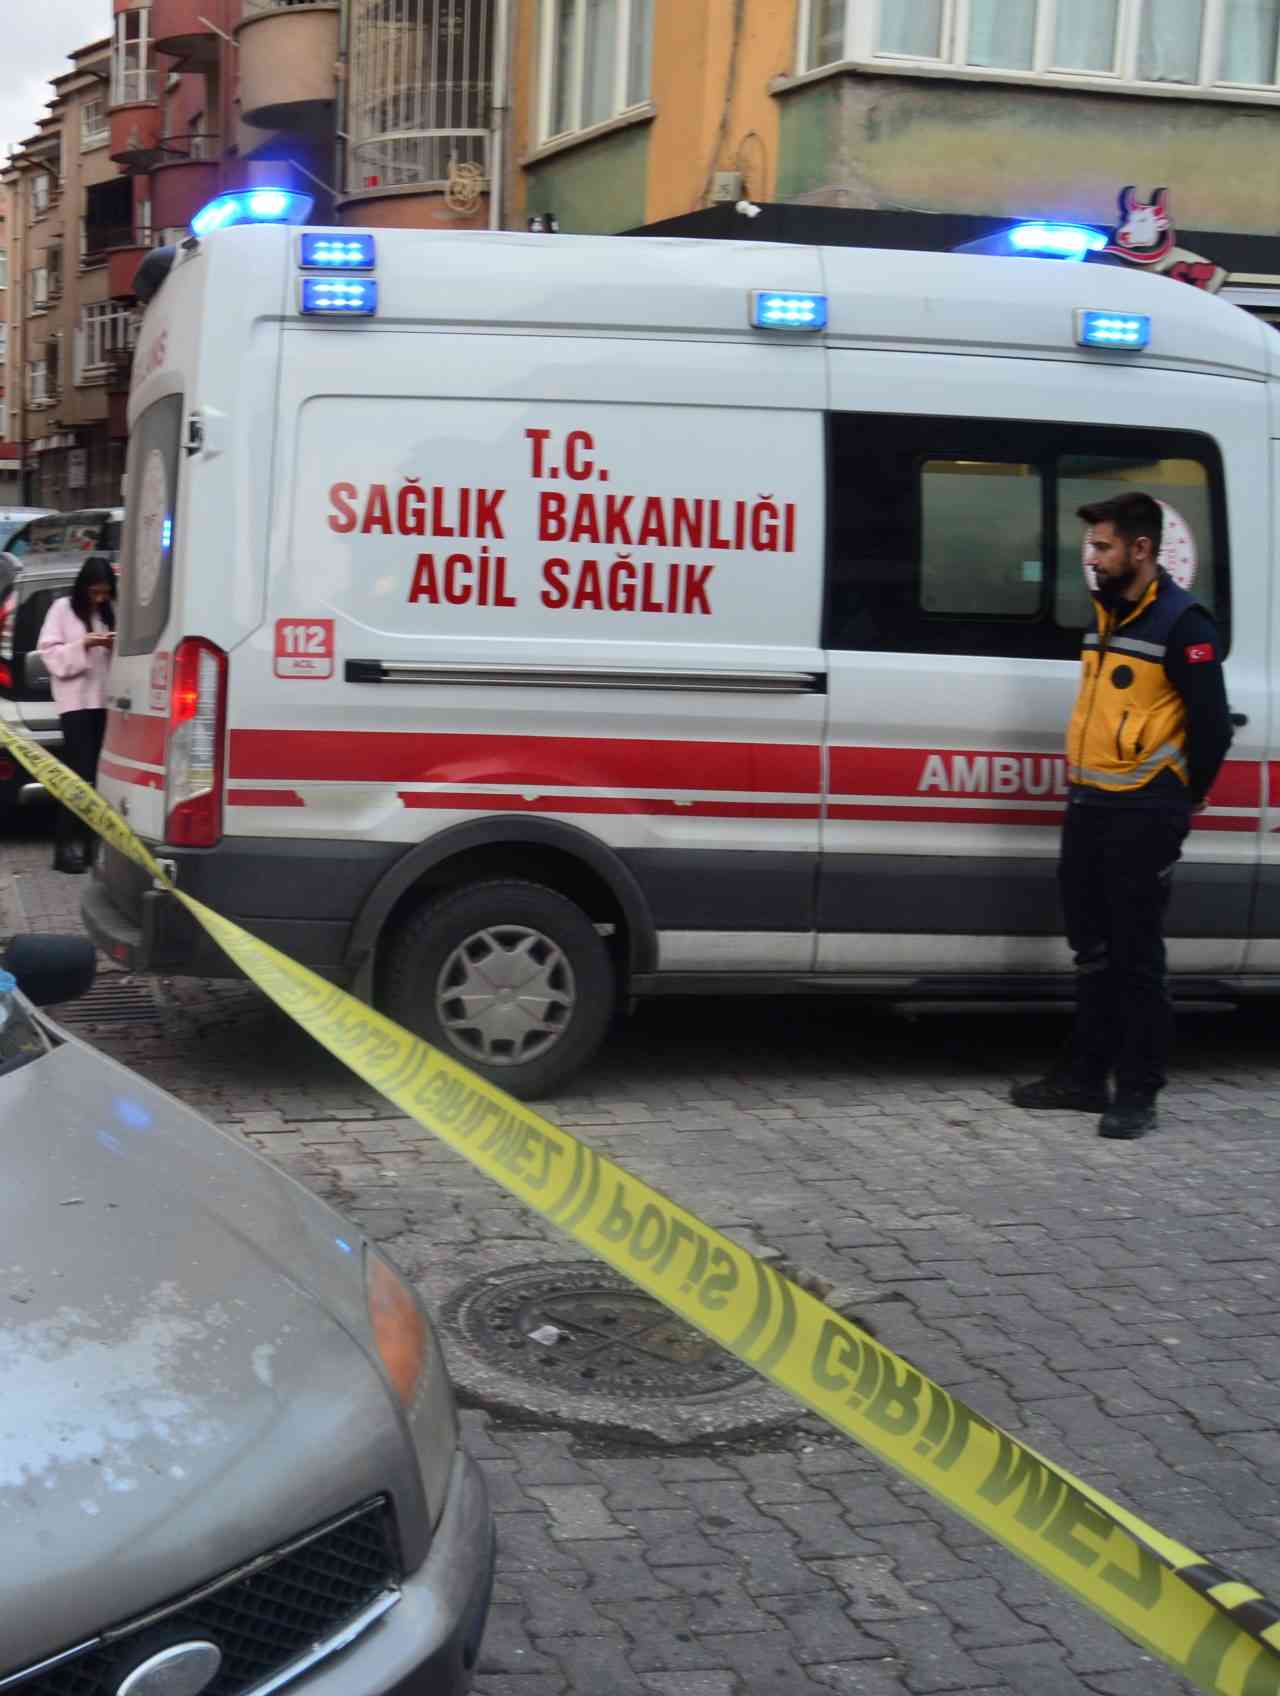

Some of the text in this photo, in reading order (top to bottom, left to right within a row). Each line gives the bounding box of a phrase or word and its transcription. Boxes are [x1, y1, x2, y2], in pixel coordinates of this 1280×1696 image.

[524, 428, 609, 482] T.C.
[326, 477, 797, 553] SAĞLIK BAKANLIĞI
[407, 545, 716, 615] ACİL SAĞLIK
[281, 624, 327, 654] 112
[916, 754, 1070, 795] AMBUL
